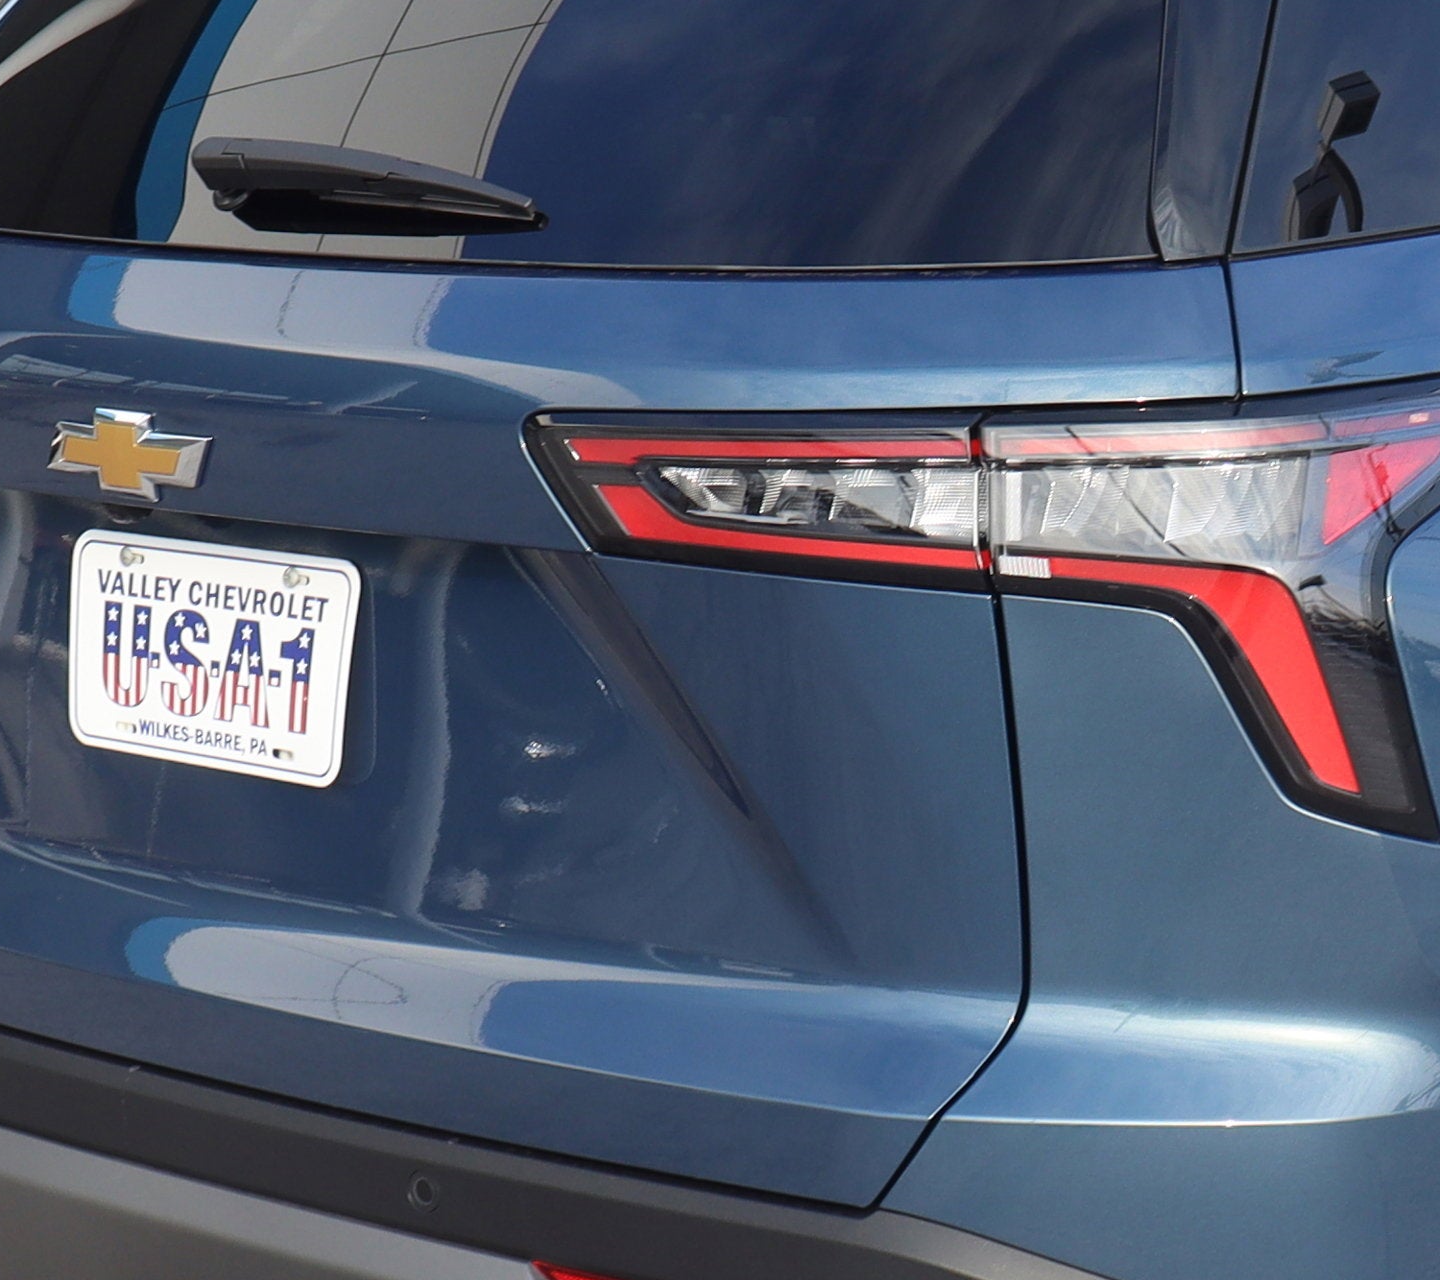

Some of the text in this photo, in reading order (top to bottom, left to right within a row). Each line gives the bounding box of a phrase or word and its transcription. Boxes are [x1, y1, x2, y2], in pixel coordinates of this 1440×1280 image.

[98, 569, 329, 623] VALLEY CHEVROLET
[138, 718, 268, 756] WILKES-BARRE, PA
